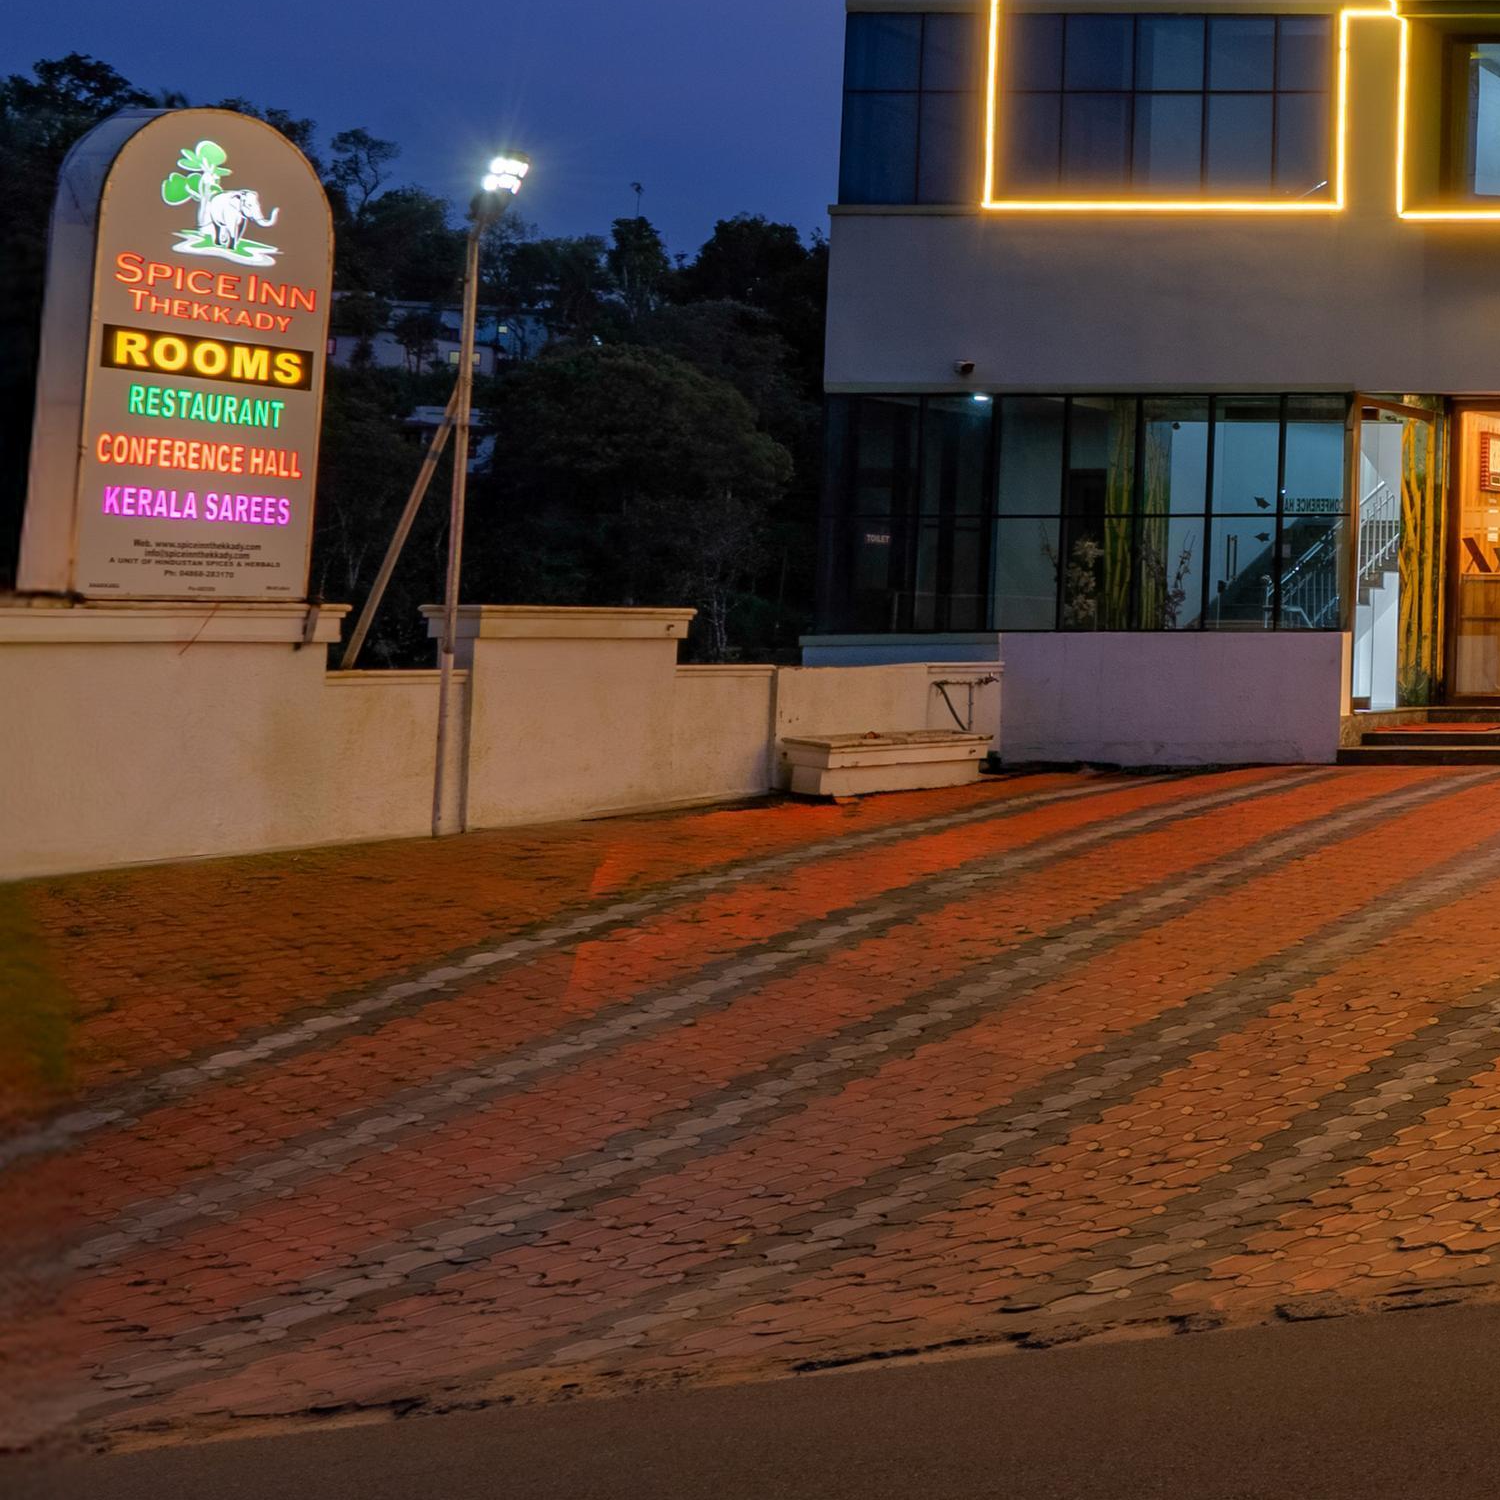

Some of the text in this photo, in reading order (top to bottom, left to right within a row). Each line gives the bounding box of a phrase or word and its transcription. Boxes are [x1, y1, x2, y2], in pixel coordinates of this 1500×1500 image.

[114, 251, 317, 312] SPICE INN
[127, 288, 293, 333] THEKKADY
[114, 330, 303, 384] ROOMS
[128, 383, 285, 429] RESTAURANT
[97, 433, 302, 479] CONFERENCE HALL
[103, 485, 291, 526] KERALA SAREES
